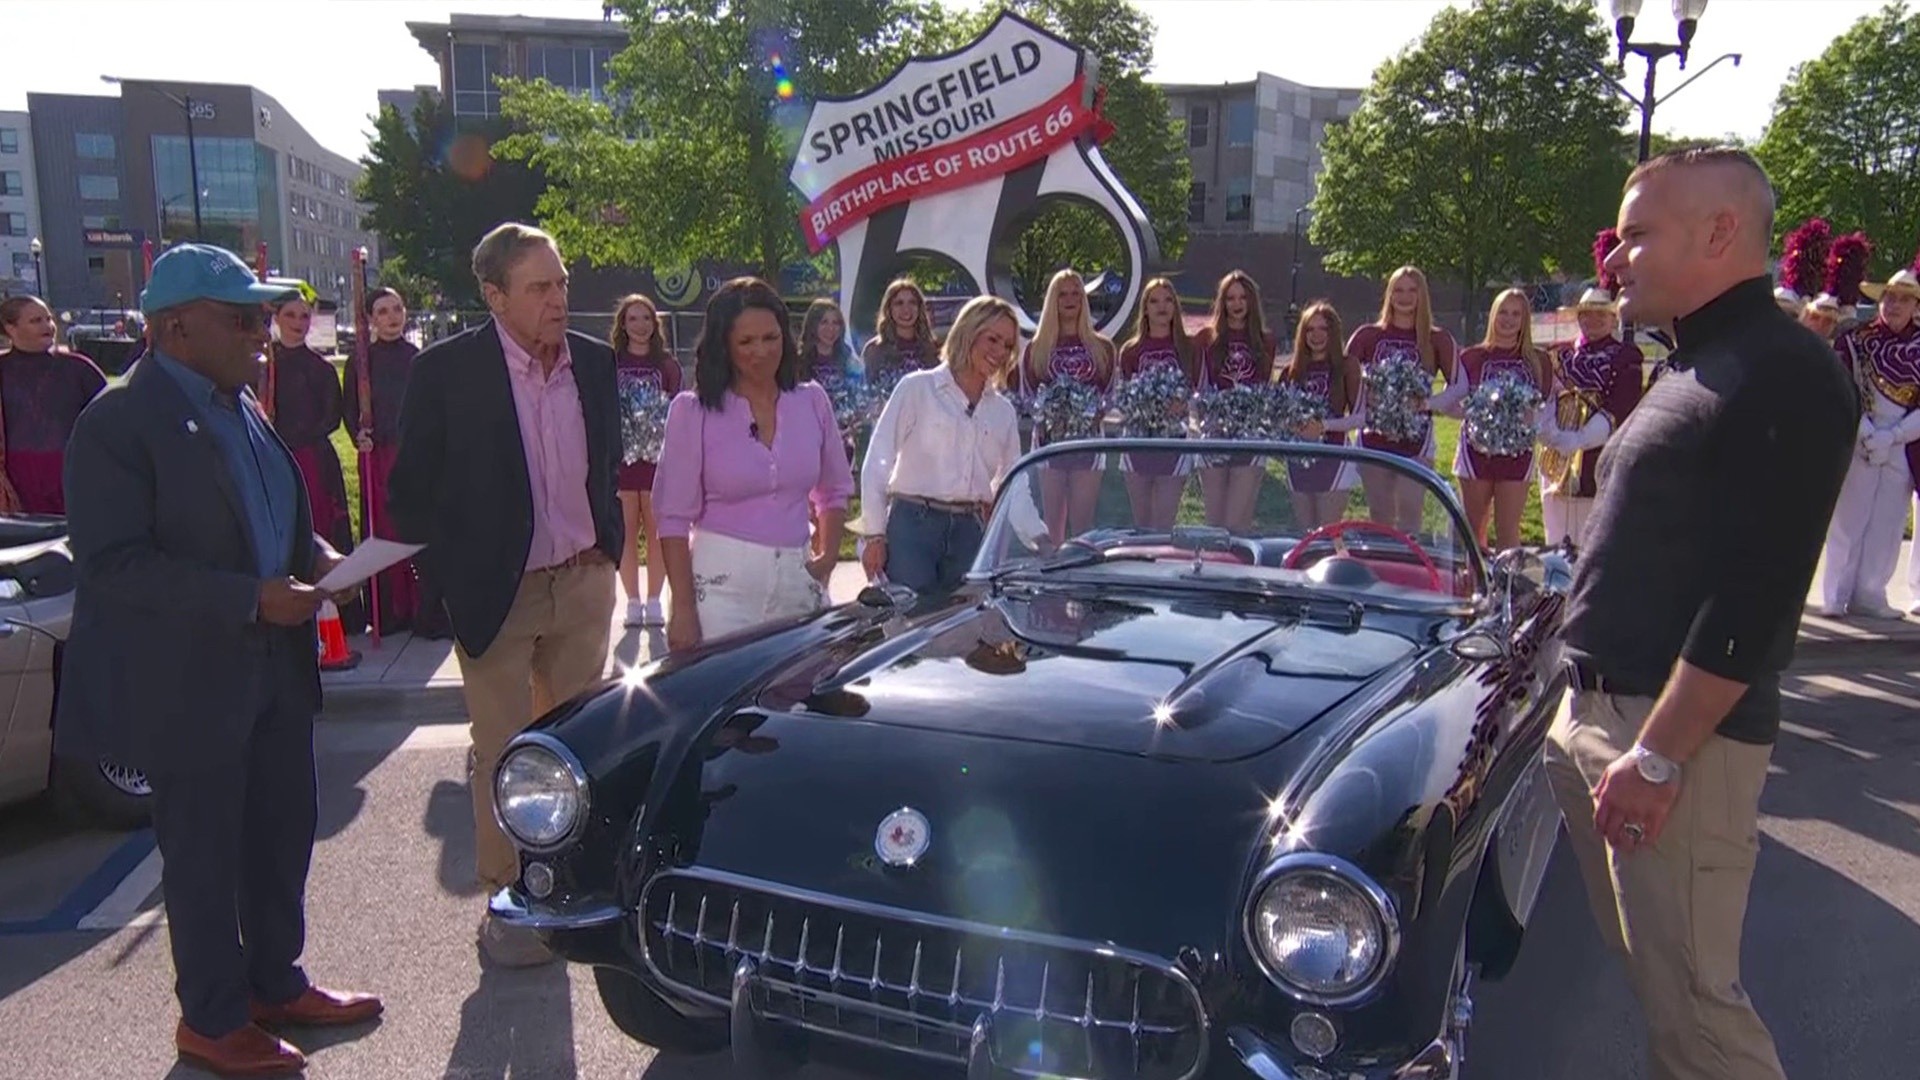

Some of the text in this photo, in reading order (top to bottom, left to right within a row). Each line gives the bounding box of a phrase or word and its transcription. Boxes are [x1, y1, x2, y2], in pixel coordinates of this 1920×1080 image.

[810, 40, 1041, 163] SPRINGFIELD
[873, 98, 996, 164] MISSOURI
[811, 105, 1074, 234] BIRTHPLACE OF ROUTE 66
